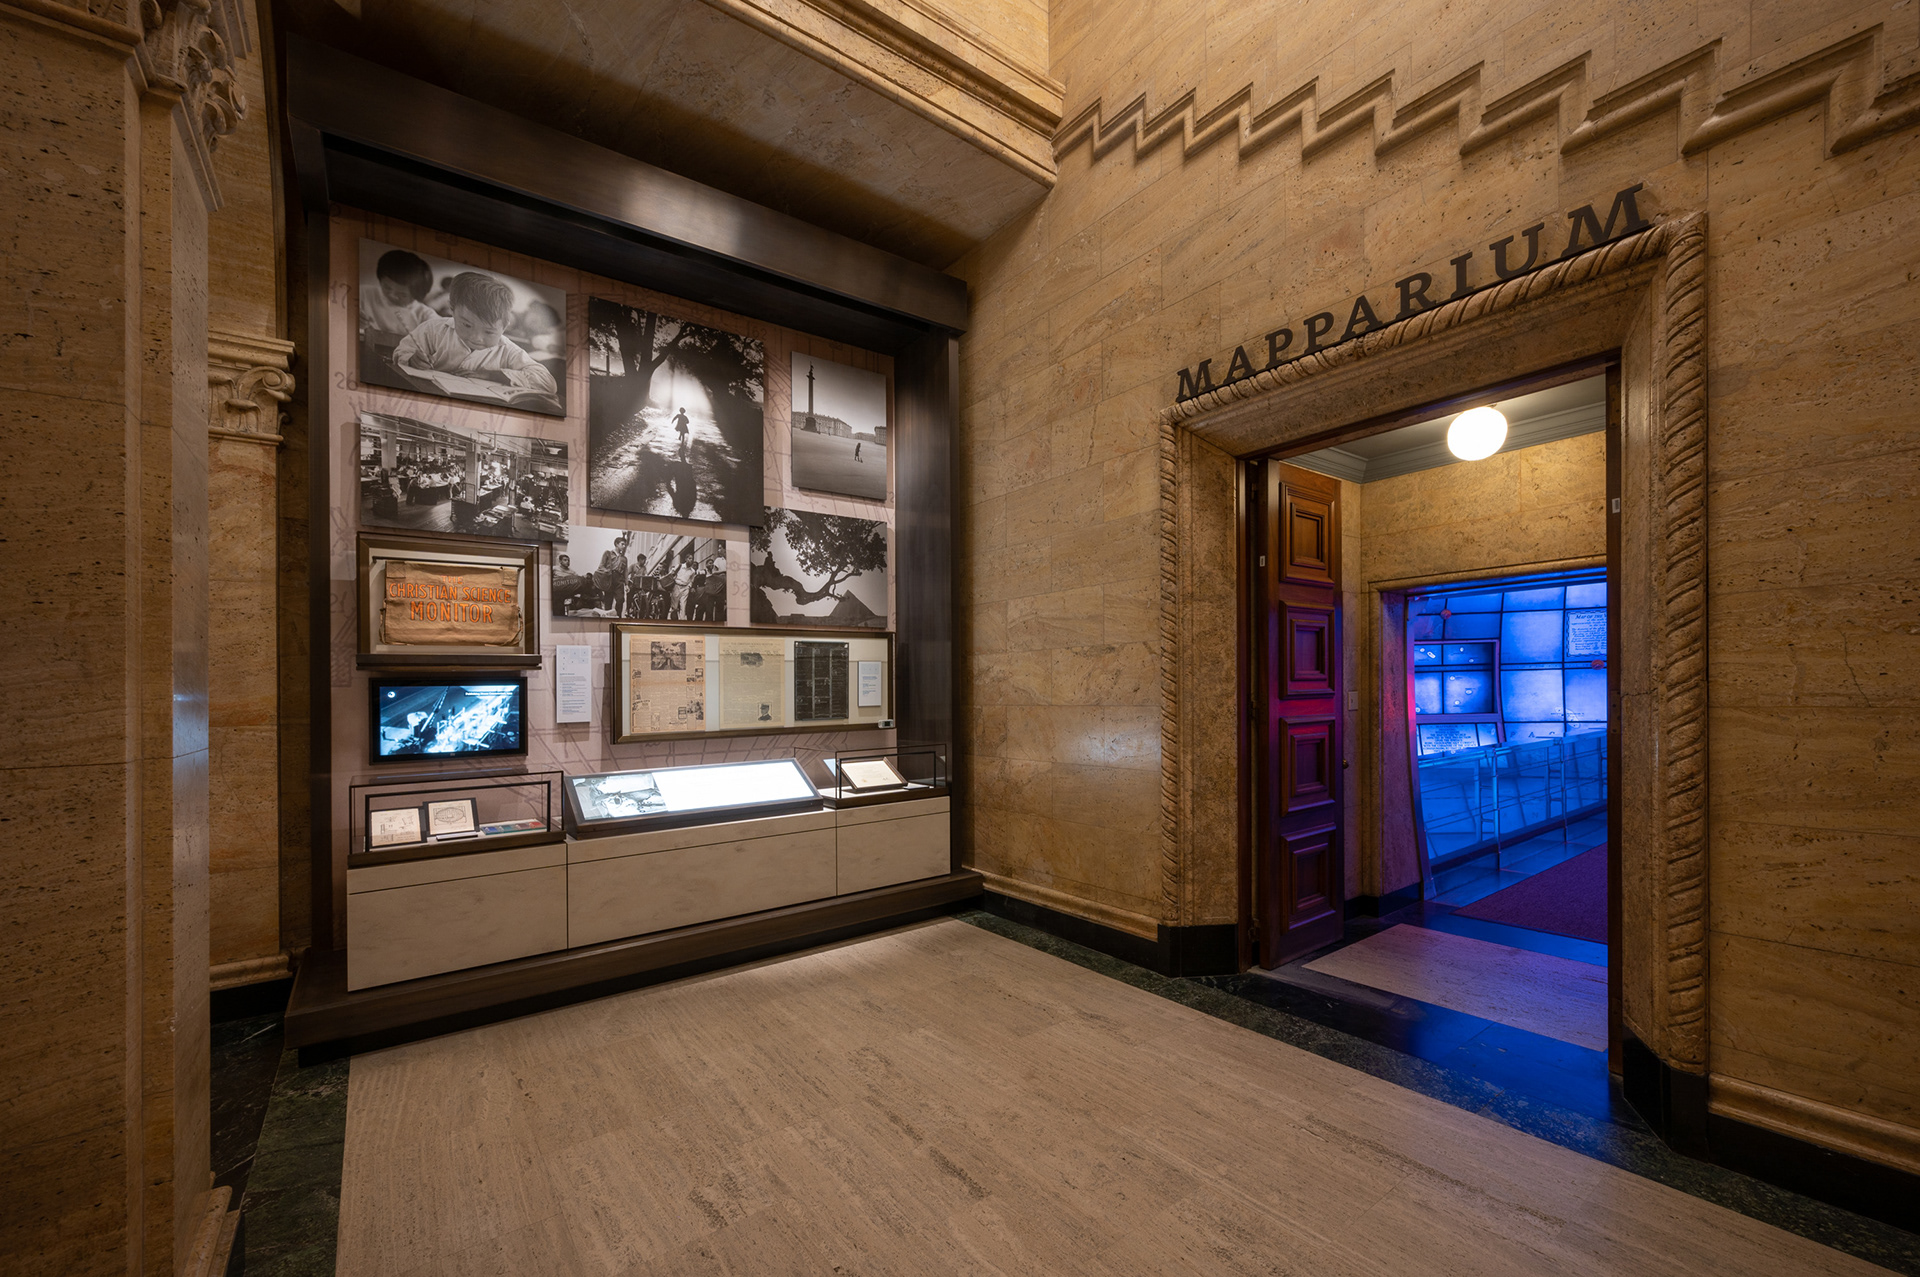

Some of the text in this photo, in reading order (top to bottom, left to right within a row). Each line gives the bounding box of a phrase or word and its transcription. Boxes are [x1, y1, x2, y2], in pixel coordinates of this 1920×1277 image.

[1175, 182, 1653, 402] MAPPARIUM
[334, 371, 358, 391] 26
[440, 575, 464, 585] THE
[730, 580, 749, 598] 52
[389, 583, 512, 603] CHRISTIAN SCIENCE
[410, 600, 494, 624] MONITOR
